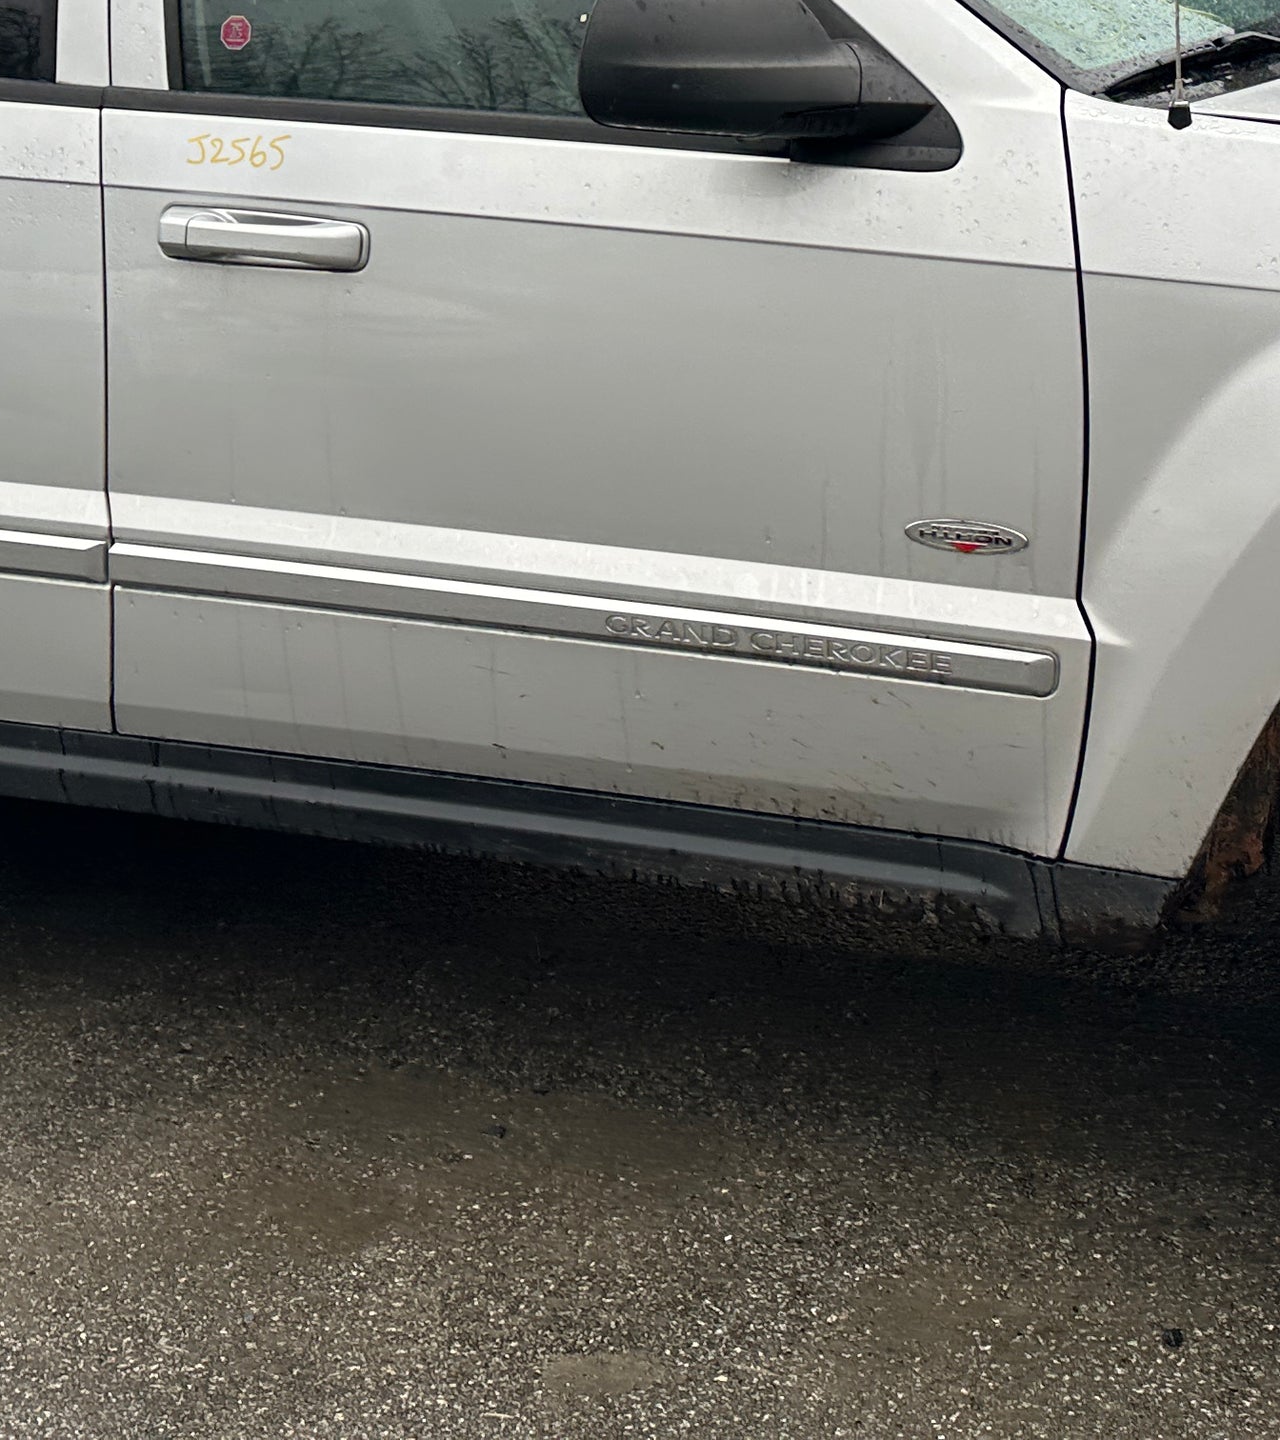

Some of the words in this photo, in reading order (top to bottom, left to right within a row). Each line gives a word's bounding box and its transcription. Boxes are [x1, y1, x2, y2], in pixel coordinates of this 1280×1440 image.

[186, 134, 292, 170] J2565
[605, 613, 737, 648] GRAND
[750, 632, 952, 676] CHEROKEE
